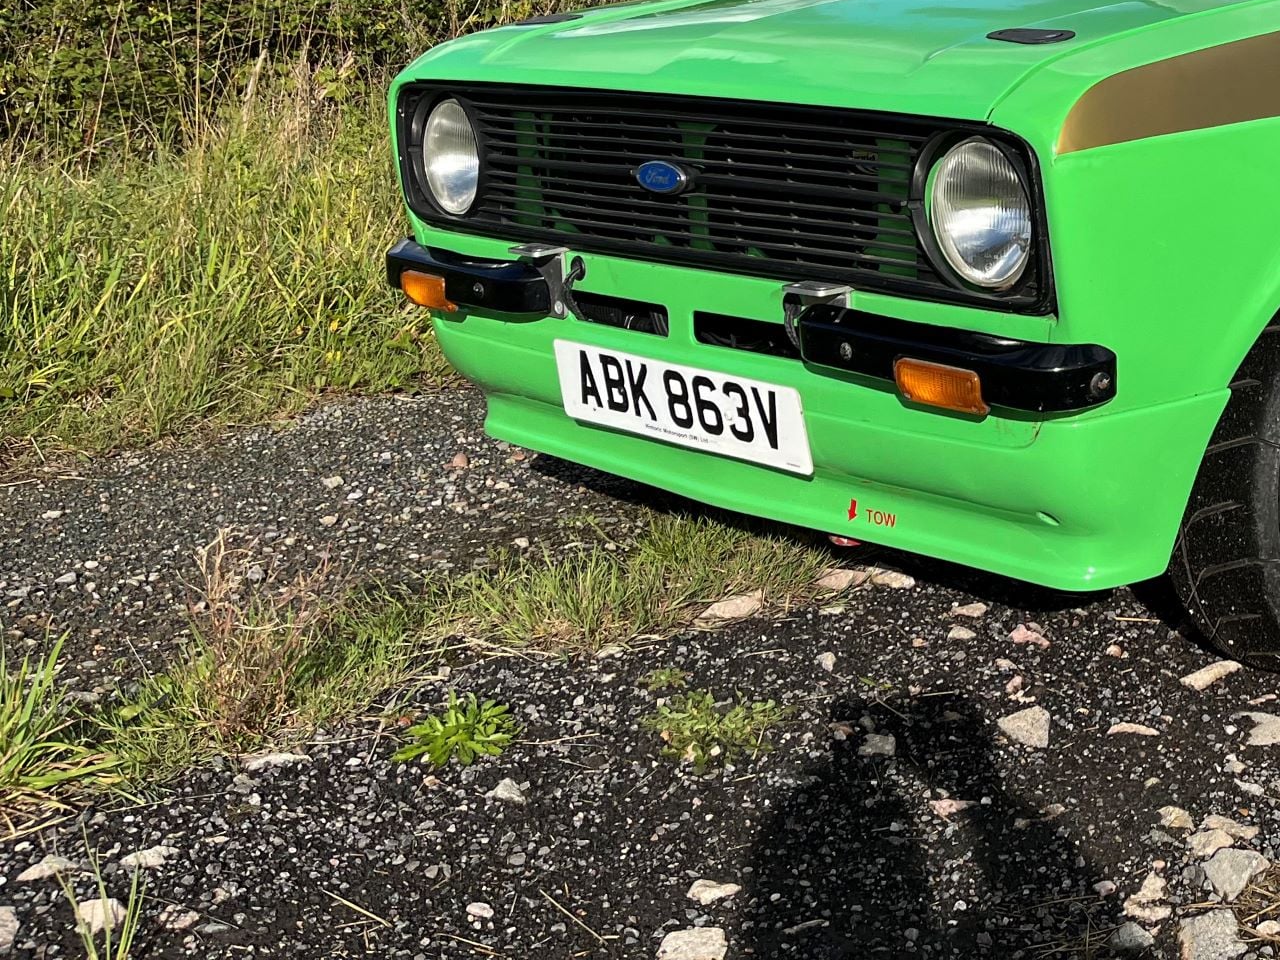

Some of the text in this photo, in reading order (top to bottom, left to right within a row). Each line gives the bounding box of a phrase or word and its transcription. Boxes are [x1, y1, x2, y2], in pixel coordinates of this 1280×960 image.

[579, 349, 780, 450] ABK 863V
[865, 508, 896, 528] TOW
